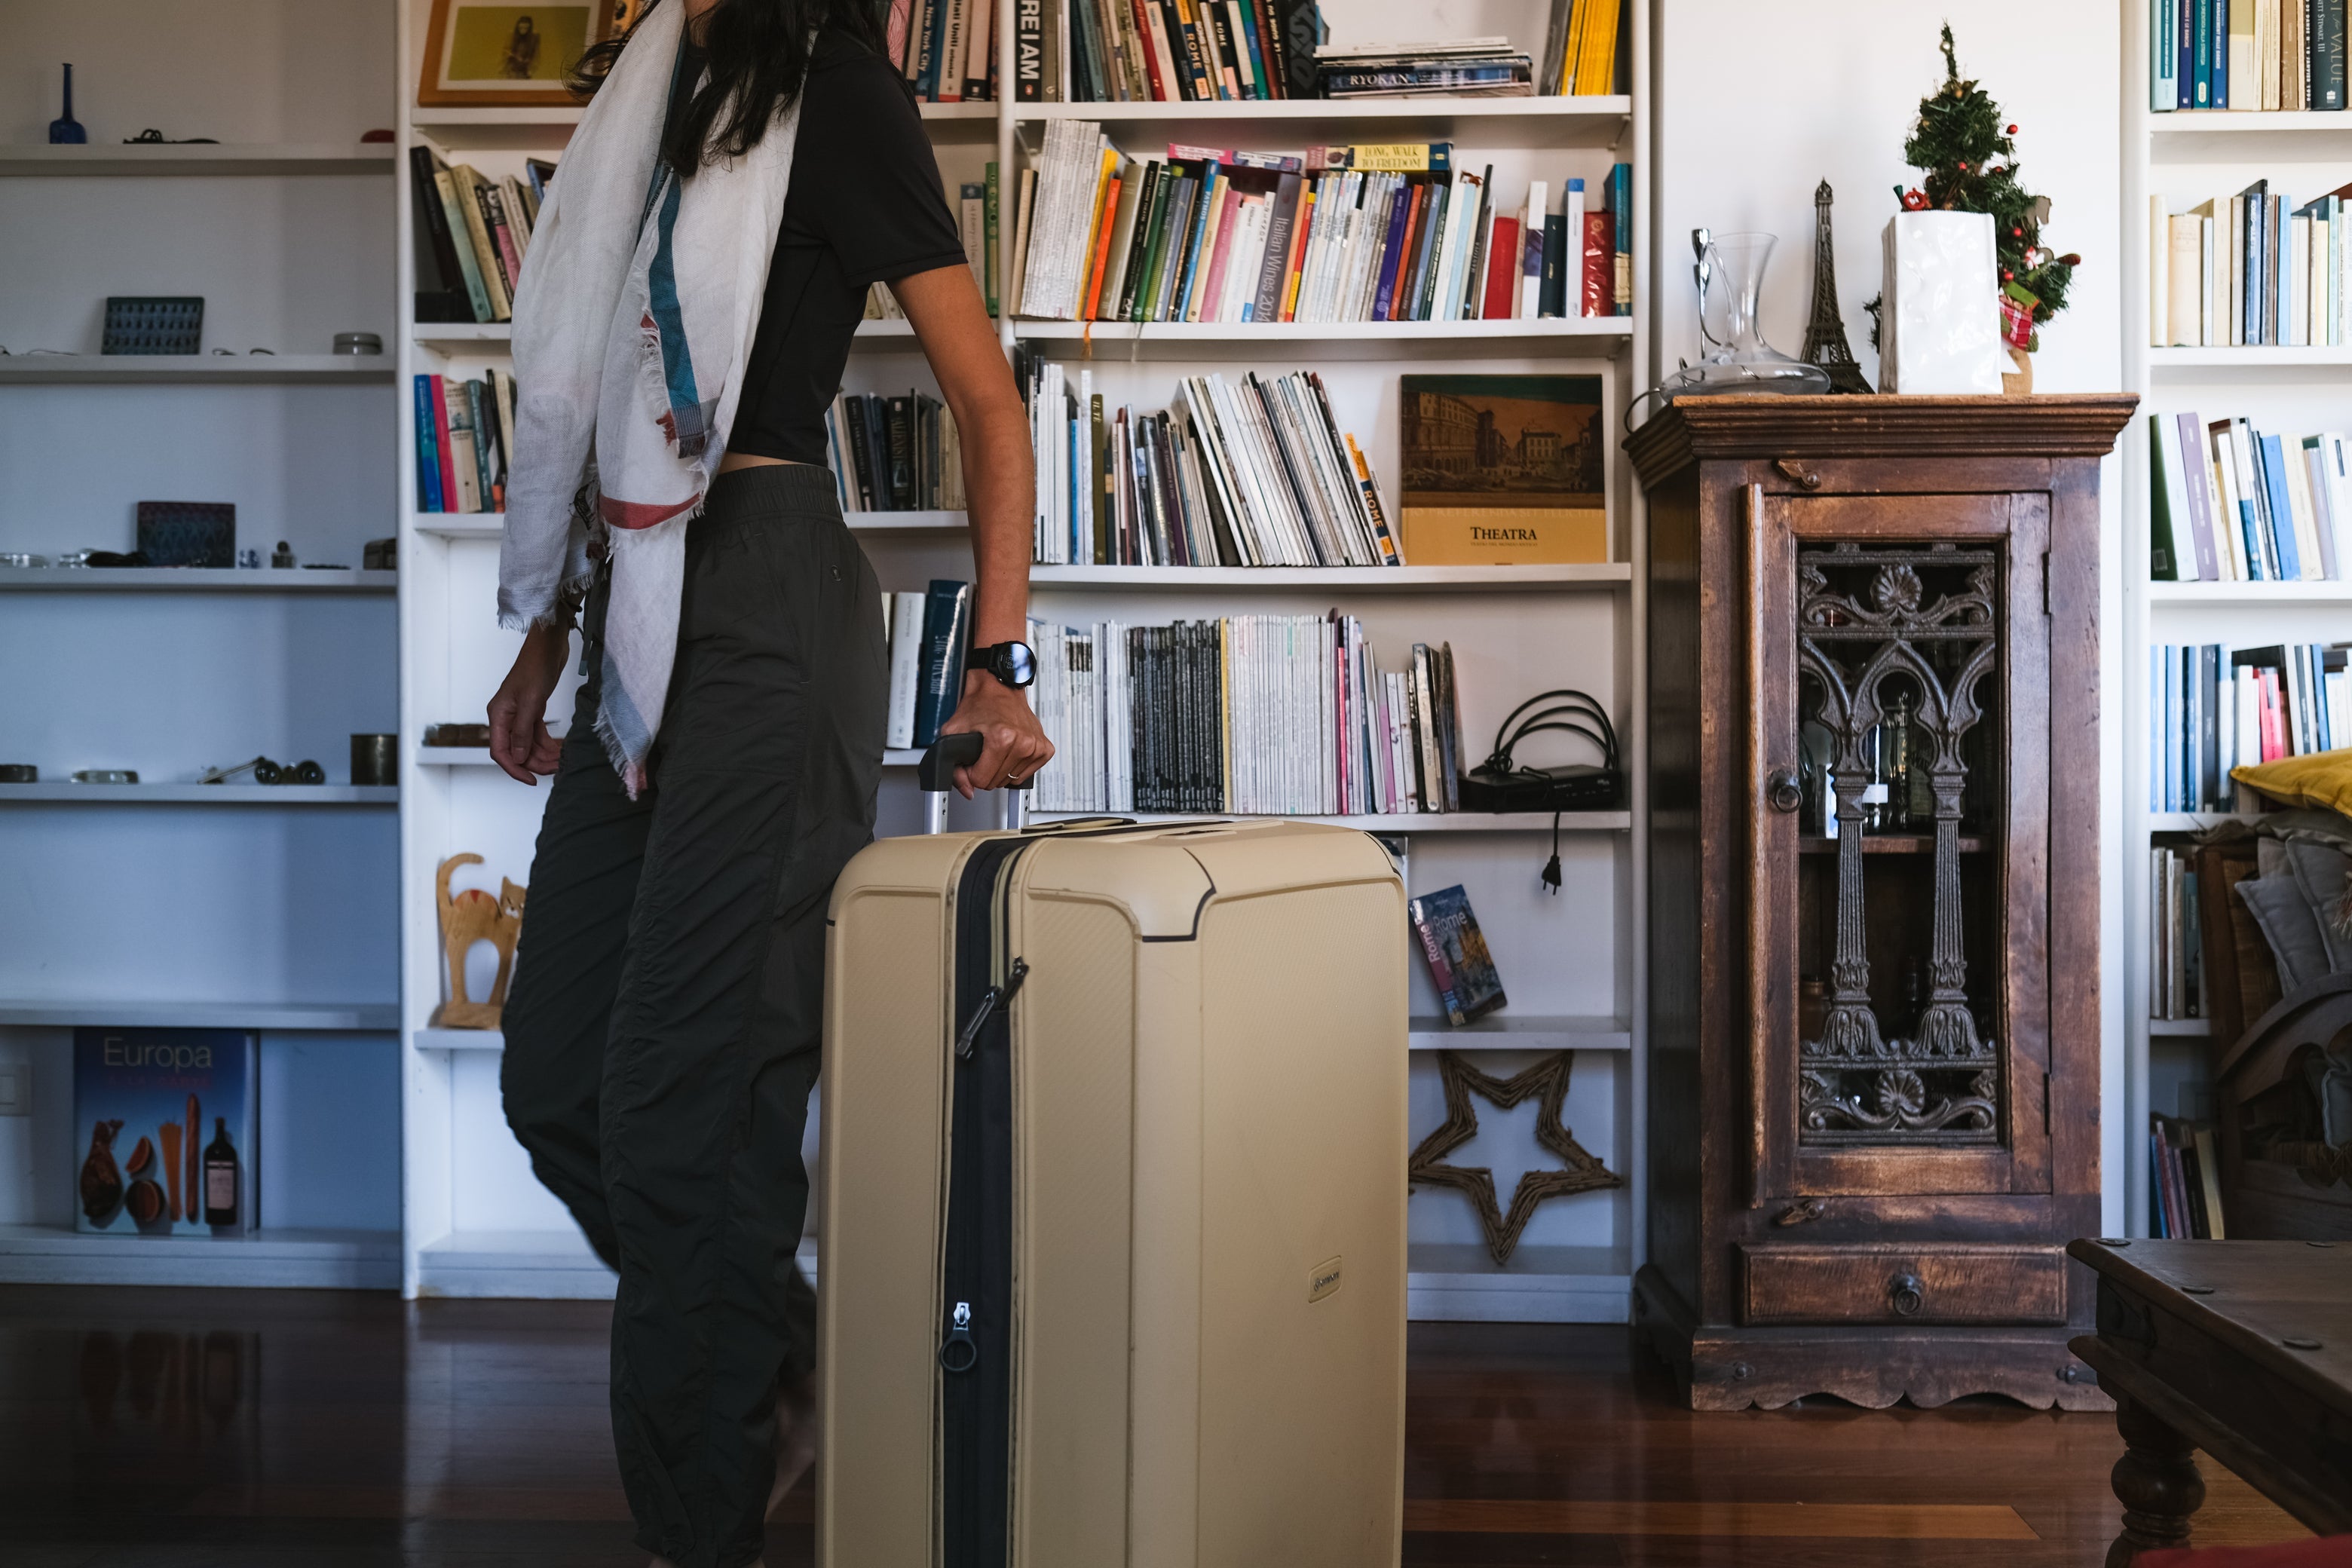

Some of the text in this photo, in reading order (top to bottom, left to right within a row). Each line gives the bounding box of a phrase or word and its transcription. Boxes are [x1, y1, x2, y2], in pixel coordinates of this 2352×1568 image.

[917, 7, 934, 72] New York City
[950, 23, 960, 47] Uniti
[1215, 21, 1228, 47] ROME
[1269, 18, 1279, 40] GUIDE
[1187, 33, 1202, 69] ROME
[1273, 42, 1282, 52] LE
[2317, 43, 2326, 53] III
[2330, 32, 2343, 84] VALUE
[947, 48, 955, 78] orientali
[1349, 73, 1409, 85] RYOKAN
[1361, 158, 1422, 168] TO FREEDOM
[1364, 145, 1419, 158] LONG WALK
[1200, 191, 1211, 221] PATMOS
[1269, 217, 1289, 253] Italian
[1262, 256, 1282, 292] Wines
[1257, 295, 1274, 323] 2014
[1092, 400, 1101, 410] IL
[1363, 491, 1384, 529] ROME
[1470, 526, 1537, 541] THEATRA
[1433, 911, 1468, 933] Rome
[1420, 924, 1441, 963] Rome
[104, 1037, 213, 1073] Europa
